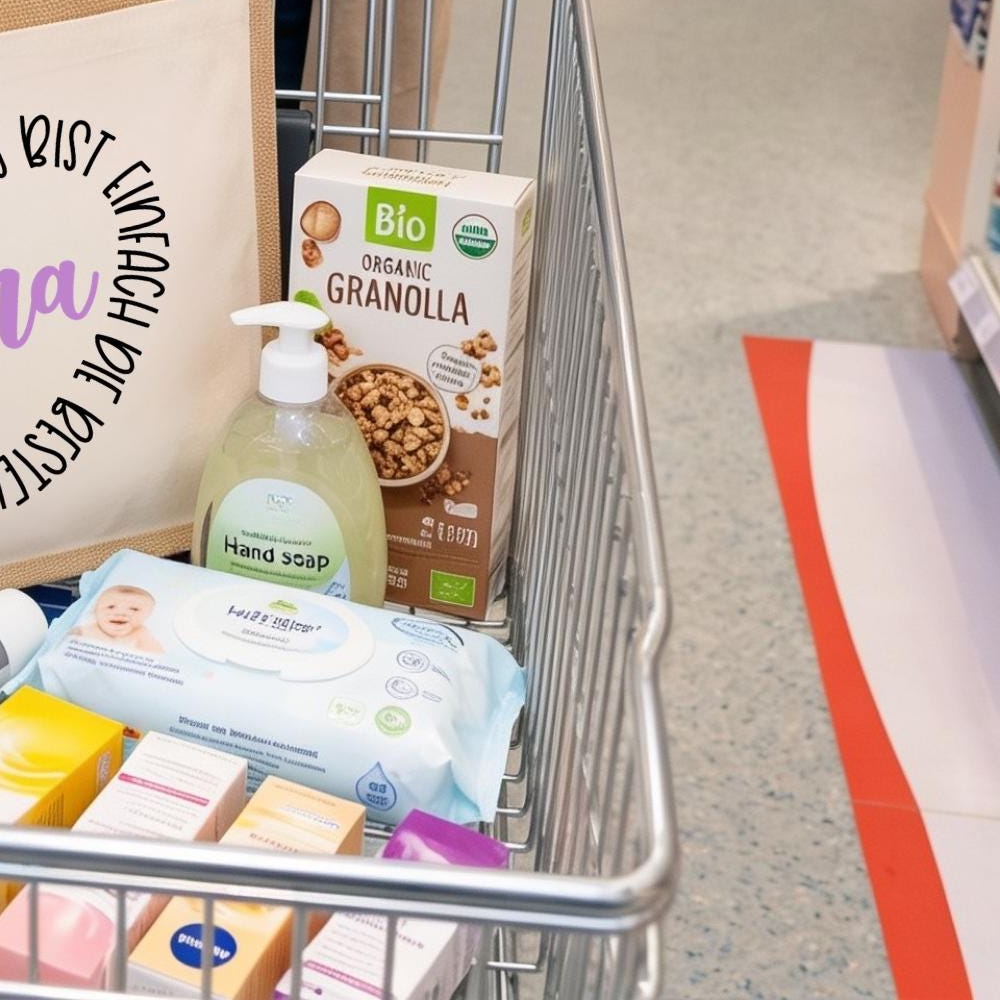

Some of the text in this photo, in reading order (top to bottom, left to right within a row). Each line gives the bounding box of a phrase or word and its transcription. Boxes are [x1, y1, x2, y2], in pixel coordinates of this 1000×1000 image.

[19, 114, 116, 177] BIST
[102, 160, 170, 328] EINFACH
[374, 202, 427, 242] Bio
[361, 253, 433, 282] ORGANIC
[326, 271, 470, 327] GRANOLLA
[72, 333, 143, 405] DIE
[224, 534, 275, 564] Hand
[281, 551, 330, 572] soap
